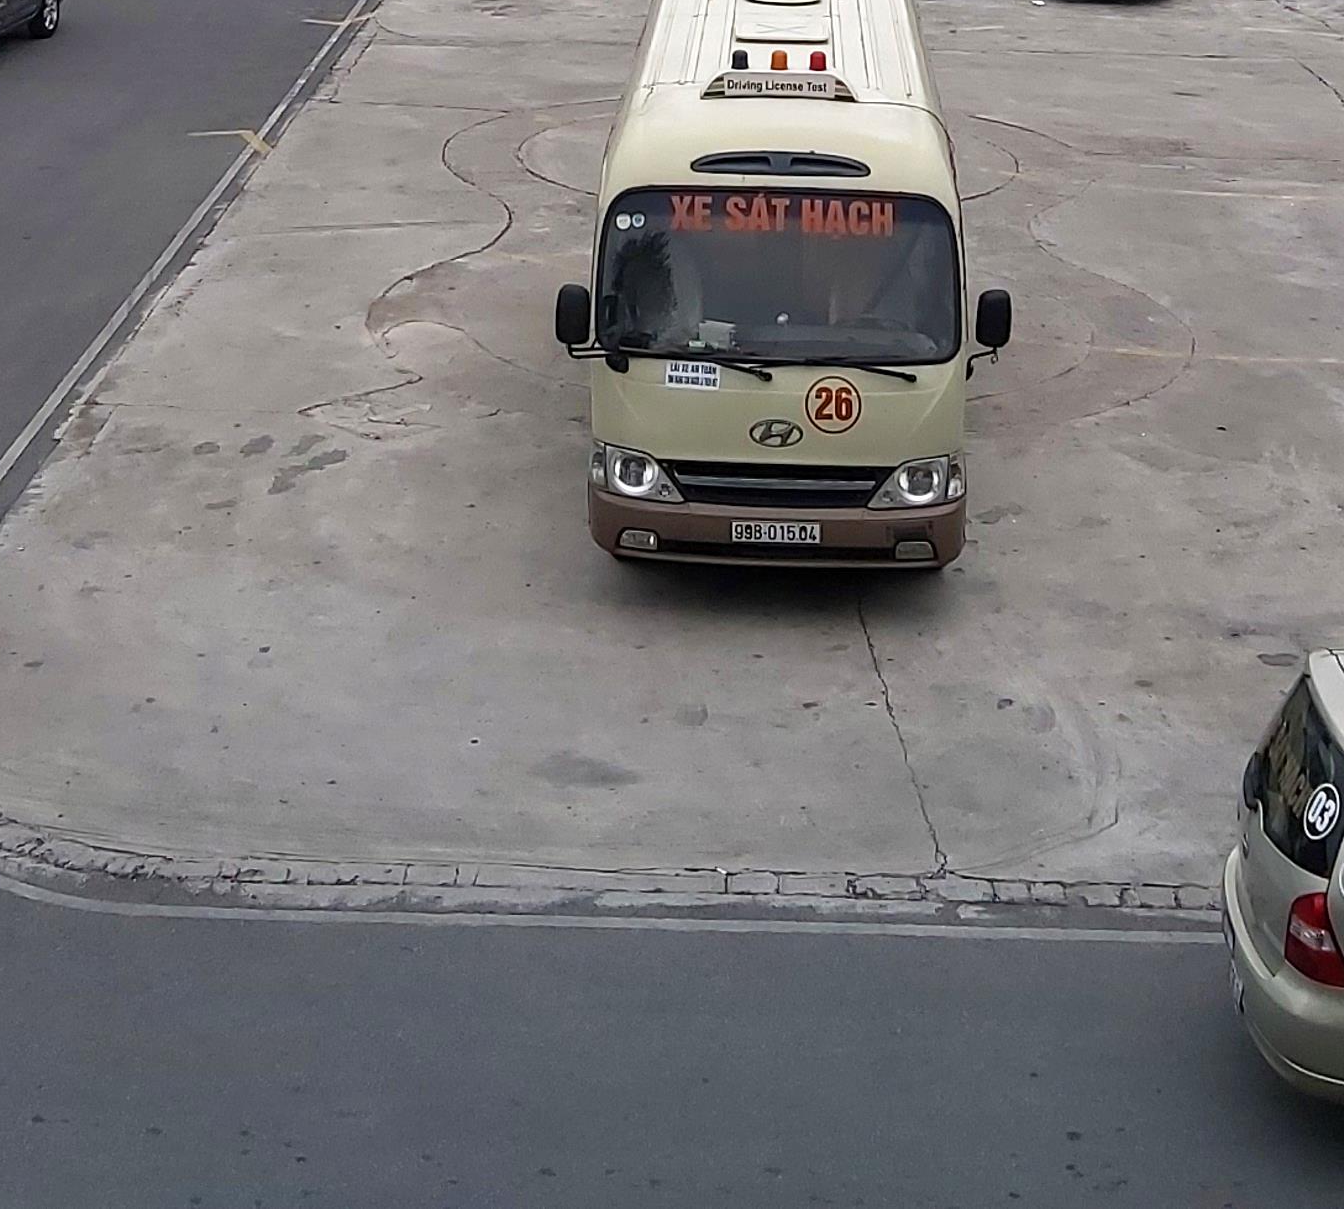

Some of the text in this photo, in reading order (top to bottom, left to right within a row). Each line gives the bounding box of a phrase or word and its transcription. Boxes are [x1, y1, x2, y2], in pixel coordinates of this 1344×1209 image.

[727, 79, 827, 93] Driving License Test
[671, 195, 713, 232] XE
[725, 193, 791, 233] SÁT
[814, 386, 854, 422] 26
[1308, 791, 1337, 833] 03
